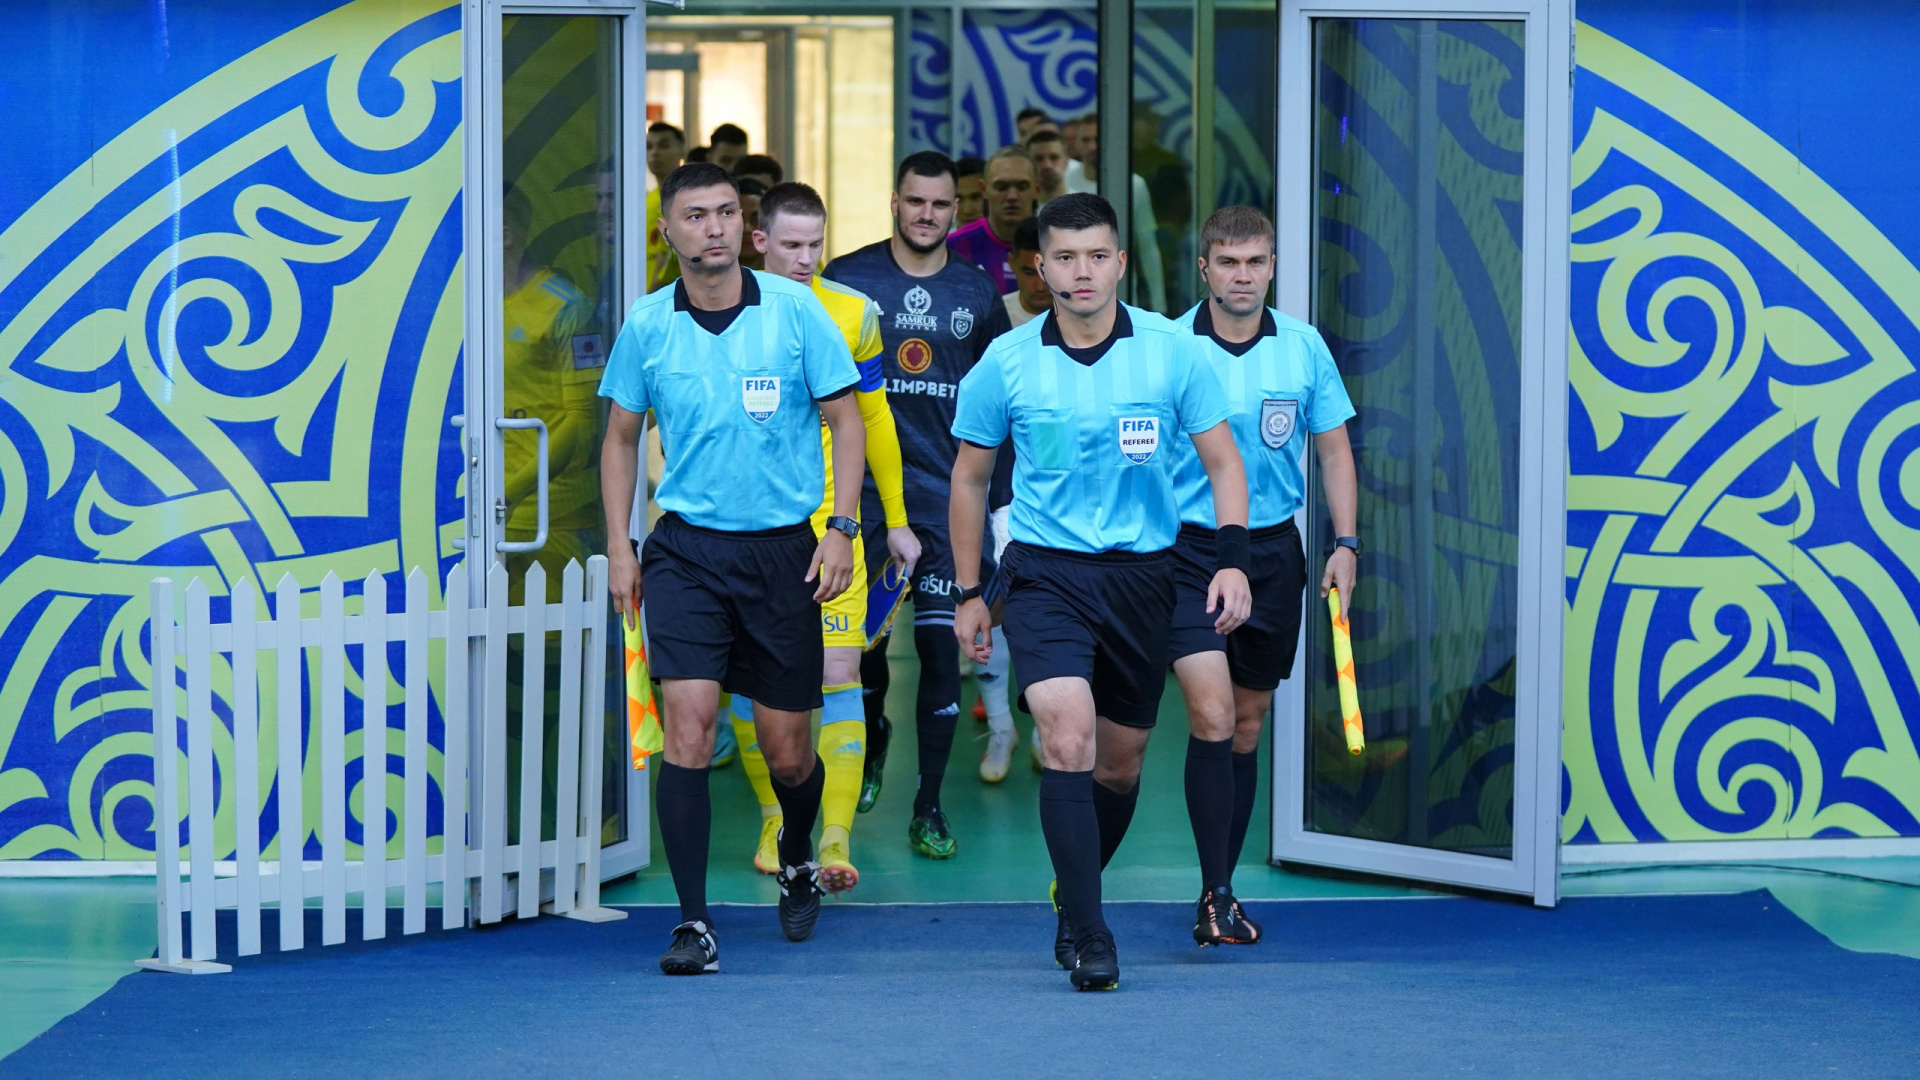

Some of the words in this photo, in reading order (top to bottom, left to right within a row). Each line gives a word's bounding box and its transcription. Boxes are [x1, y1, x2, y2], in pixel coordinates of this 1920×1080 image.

[896, 314, 937, 327] SAMRUK
[895, 323, 937, 332] KAZYNA
[746, 380, 776, 391] FIFA
[883, 378, 957, 398] LIMPBET
[1123, 420, 1155, 432] FIFA
[1122, 438, 1155, 446] REFEREE
